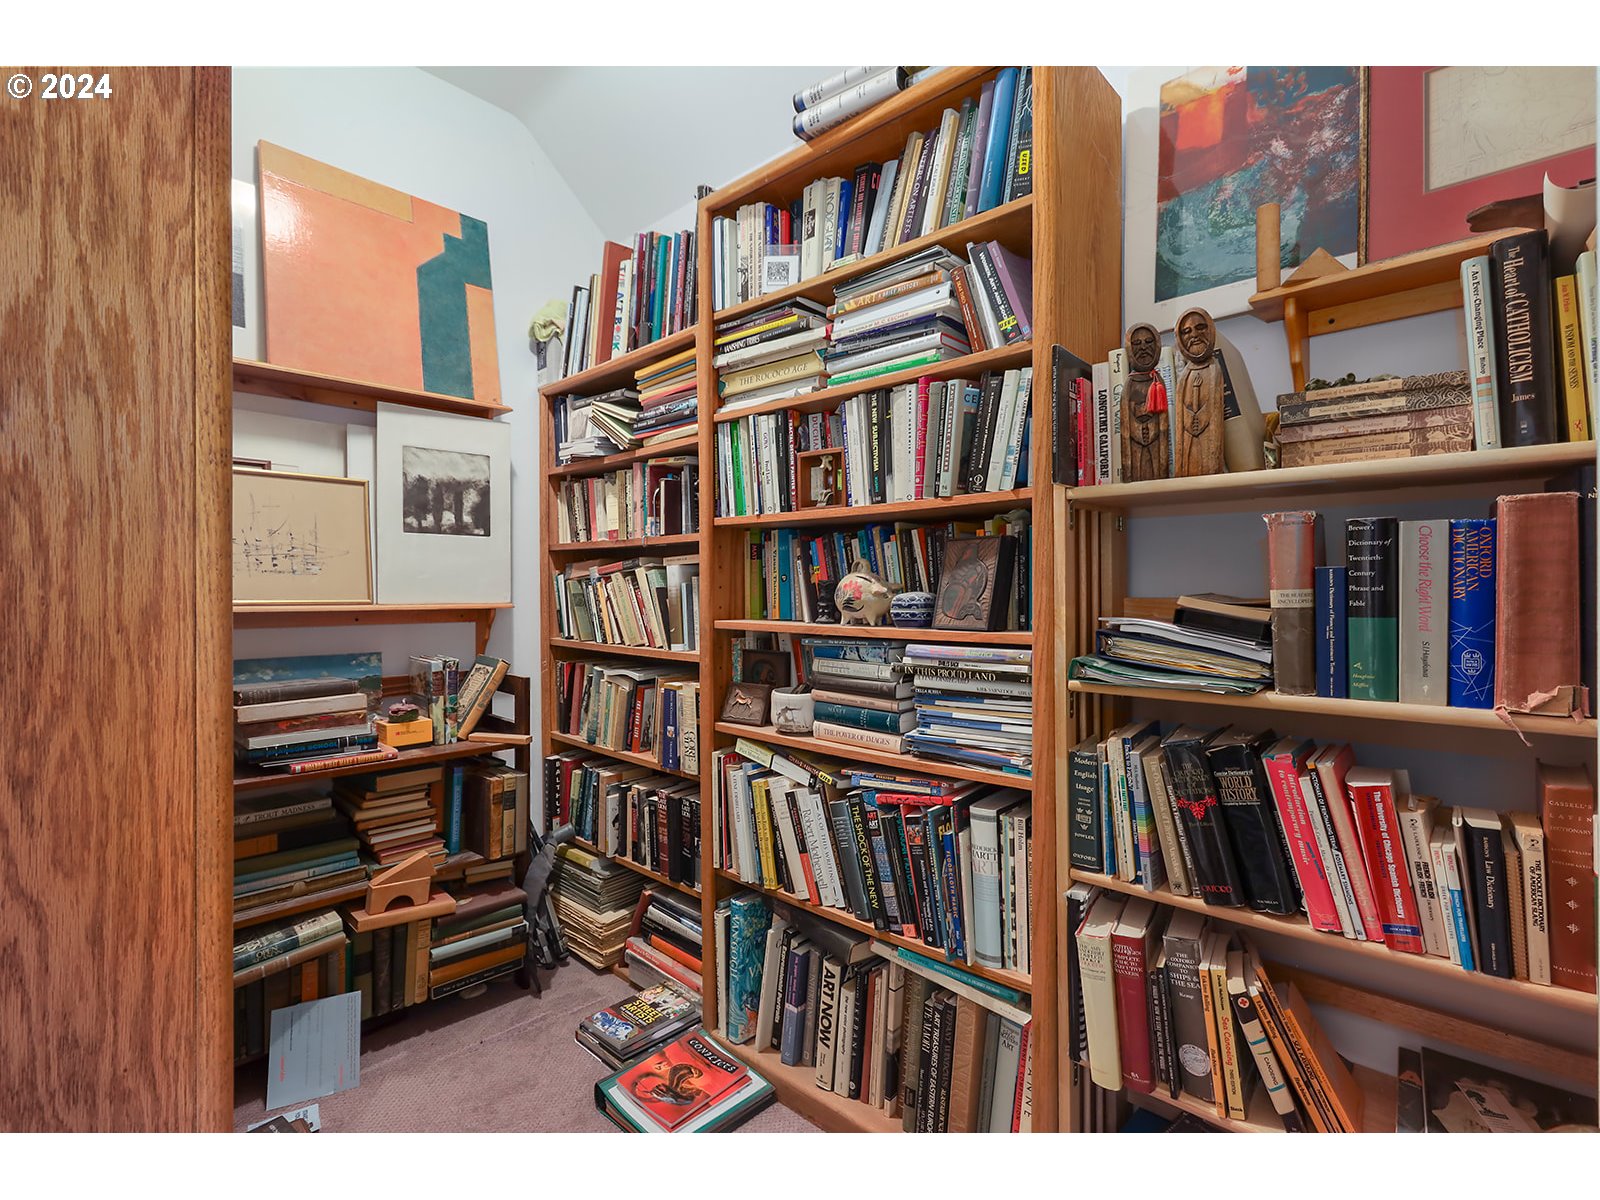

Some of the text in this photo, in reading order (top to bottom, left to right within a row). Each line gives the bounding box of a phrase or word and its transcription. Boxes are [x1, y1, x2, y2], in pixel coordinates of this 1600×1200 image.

[1020, 153, 1028, 172] USED
[902, 137, 930, 234] WRITERS ON ARTISTS
[855, 293, 877, 306] ART
[1470, 269, 1487, 374] An Ever-Changing Place Bishop
[1501, 245, 1536, 384] The Heart of CATHOLICISM
[1562, 323, 1575, 349] WISDOM
[738, 362, 809, 386] THE ROCOCO AGE
[1567, 366, 1579, 389] SENSES
[1511, 392, 1536, 403] James
[1097, 388, 1109, 433] LONGTIME
[871, 424, 880, 471] SUBJECTIVISM
[1348, 524, 1375, 533] Brewer's
[1348, 538, 1392, 547] Dictionary of
[1479, 526, 1492, 578] OXFORD
[1348, 554, 1384, 562] Twentieth-
[1452, 527, 1466, 600] DICTIONARY
[1465, 527, 1478, 590] AMERICAN
[1348, 569, 1376, 578] Century
[1417, 525, 1433, 633] Choose the Right Word
[1348, 584, 1384, 592] Phrase and
[1348, 599, 1366, 608] Fable
[903, 664, 996, 682] IN THIS PROUD LAND
[822, 727, 890, 746] THE POWER OF IMAGES
[1073, 756, 1098, 766] Modern
[1073, 769, 1098, 780] English
[1218, 776, 1252, 788] WORLD
[1277, 769, 1286, 779] to
[1075, 783, 1096, 794] Usage
[1219, 788, 1258, 801] HISTORY
[1286, 772, 1307, 825] introduction
[254, 811, 278, 820] TROUT
[1280, 778, 1302, 839] contemporary
[1549, 799, 1593, 810] CASSELL'S
[867, 813, 877, 821] ART
[868, 820, 878, 828] ART
[1016, 818, 1025, 850] Bill Holm
[1549, 825, 1593, 836] DICTIONARY
[800, 808, 831, 890] Robert Motherwell
[814, 811, 836, 884] AS OF THIS WRITING
[850, 804, 879, 909] THE SHOCK OF THE NEW
[1296, 838, 1310, 865] music
[1372, 790, 1406, 919] The University of Chicago Spanish Dictionary
[1333, 852, 1355, 905] ROSEMARY SIMMONS
[1484, 859, 1494, 875] Law
[943, 850, 959, 918] FLOORCLOTH MAGIC
[1201, 884, 1233, 893] OXFORD
[1483, 874, 1497, 910] Dictionary
[1535, 872, 1543, 898] POCKET
[1528, 865, 1539, 927] OF AMERICAN SLANG
[1536, 898, 1545, 933] DICTIONARY
[727, 914, 740, 979] VAN GOGH
[1167, 961, 1200, 970] COMPANION
[1170, 956, 1196, 965] OXFORD
[773, 944, 787, 1023] Expressionist Portraits
[1169, 972, 1191, 980] SHIPS
[1171, 979, 1201, 989] THE SEA
[1179, 991, 1194, 1000] Kemp
[623, 1002, 653, 1024] ARTISTS
[633, 999, 663, 1019] STREET
[817, 966, 836, 1049] ART NOW
[930, 1027, 940, 1067] TREASURES
[1220, 1014, 1236, 1066] Sea Canoeing
[689, 1038, 736, 1073] CONFLICTS
[929, 1067, 937, 1078] OF
[1263, 1055, 1278, 1086] CANOEING
[927, 1078, 936, 1109] EASTERN
